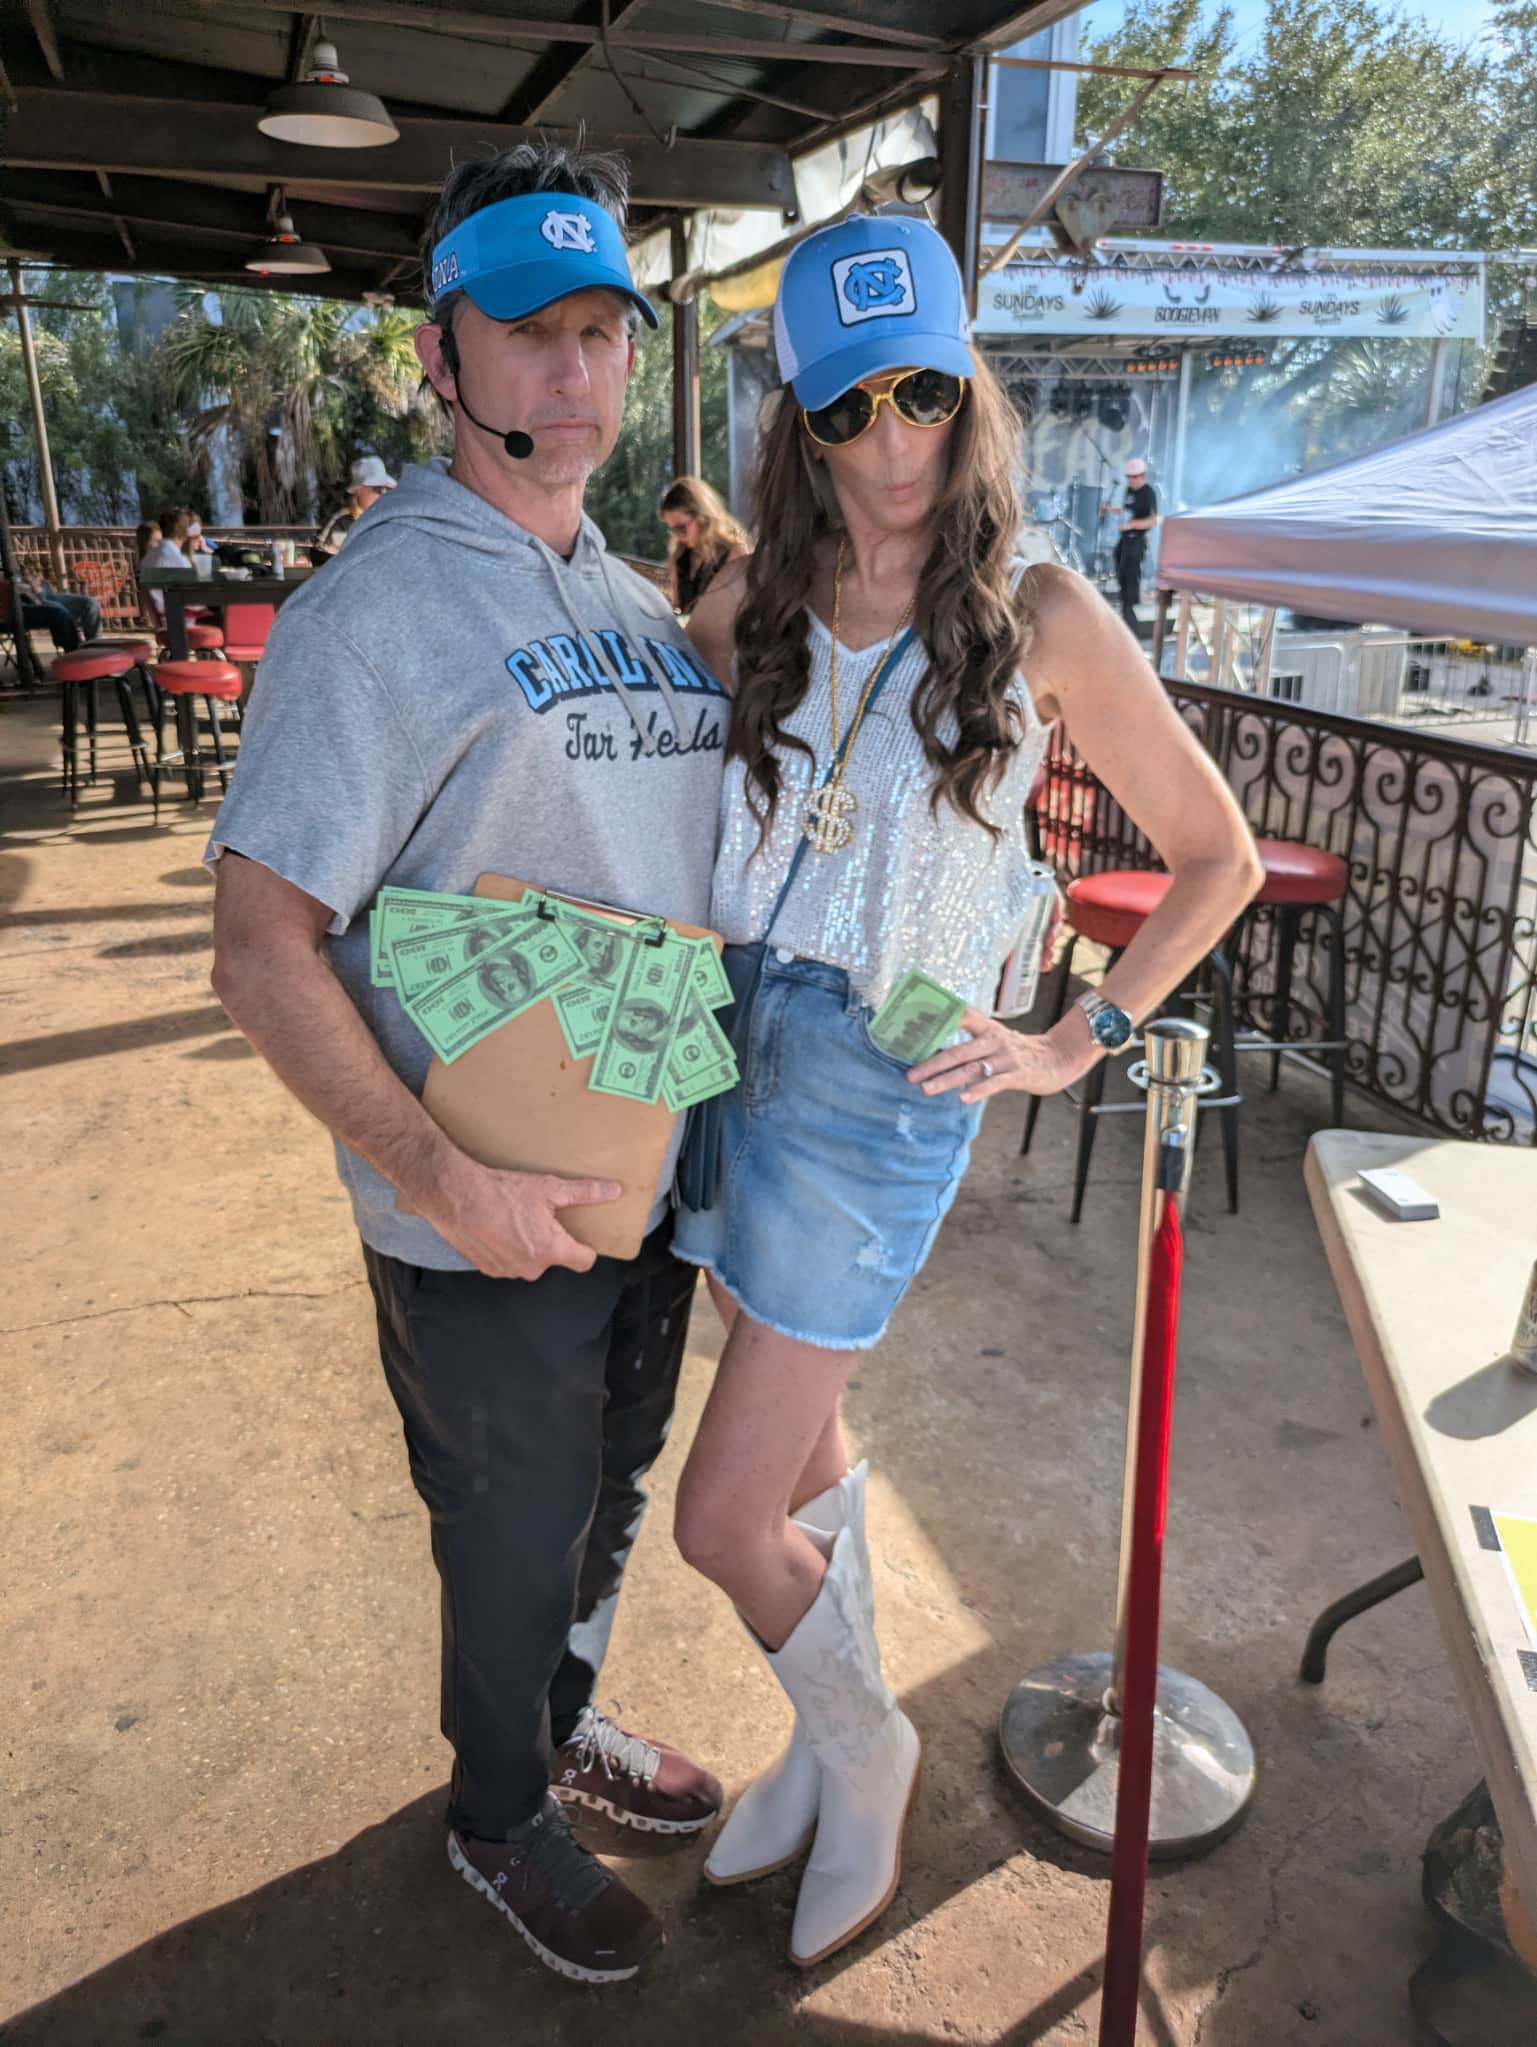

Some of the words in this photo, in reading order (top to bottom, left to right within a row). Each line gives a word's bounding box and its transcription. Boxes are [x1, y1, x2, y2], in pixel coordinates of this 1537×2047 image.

[992, 293, 1065, 312] SUNDAYS
[1299, 300, 1361, 316] SUNDAYS
[504, 629, 733, 715] CAROLN
[565, 712, 618, 761] Tar
[629, 707, 725, 762] Hels
